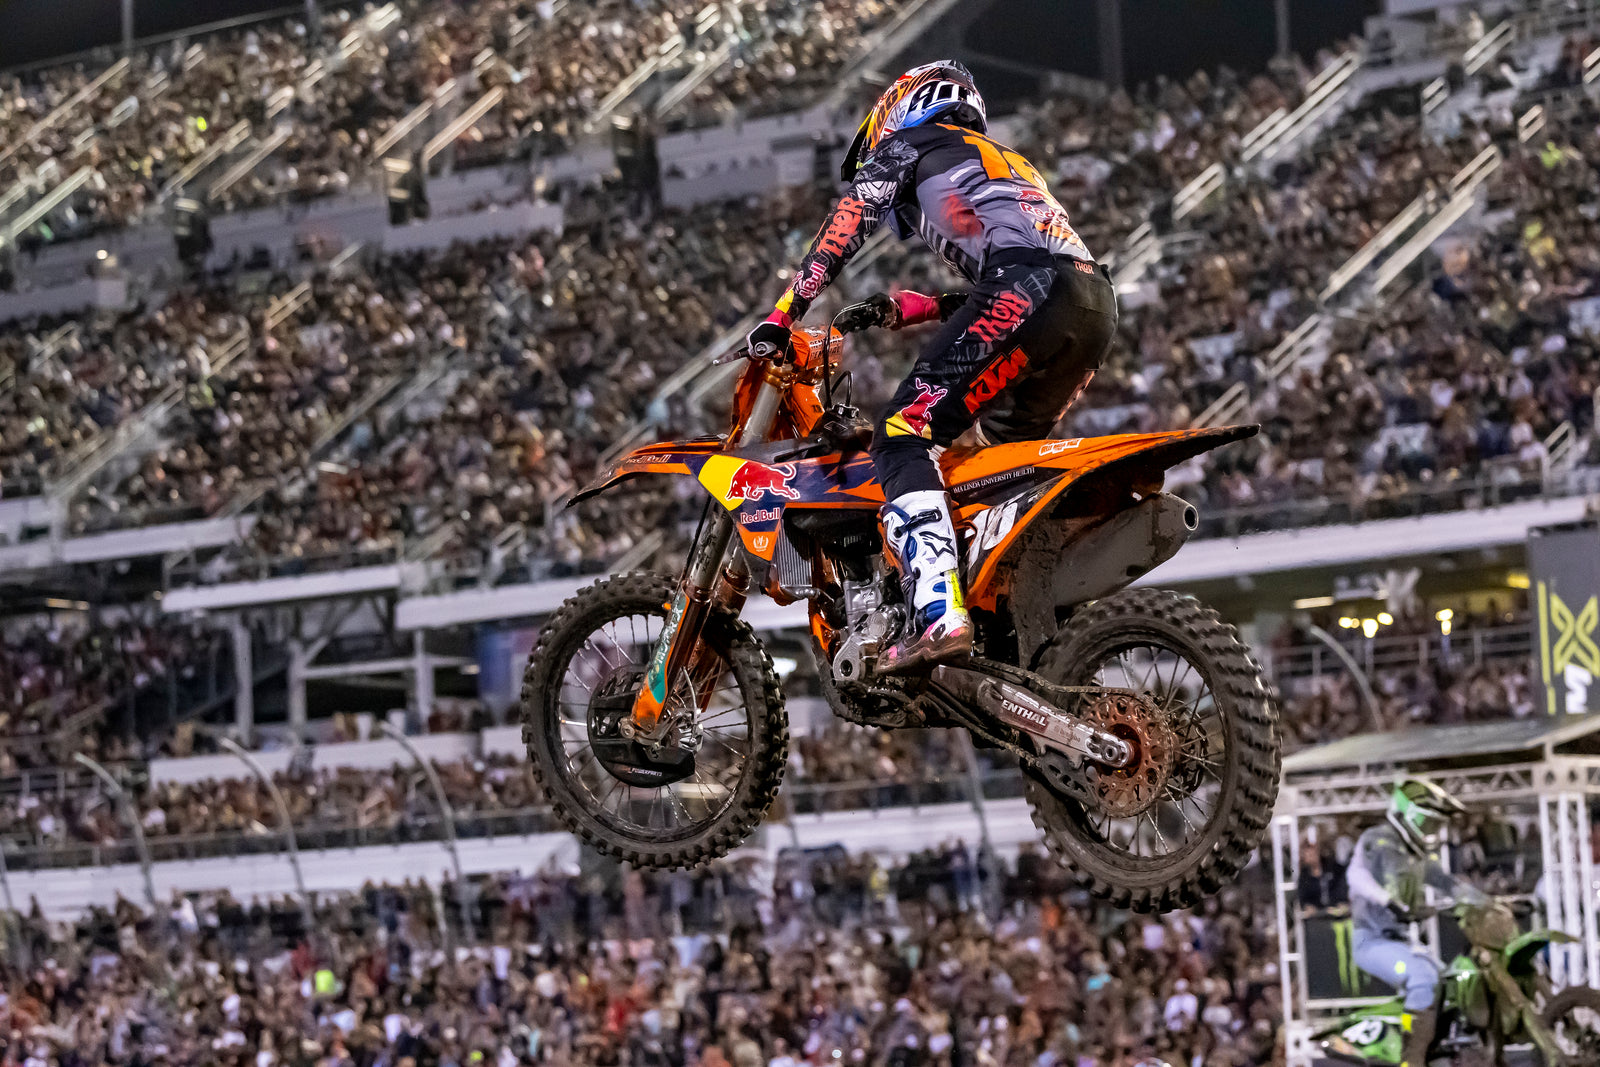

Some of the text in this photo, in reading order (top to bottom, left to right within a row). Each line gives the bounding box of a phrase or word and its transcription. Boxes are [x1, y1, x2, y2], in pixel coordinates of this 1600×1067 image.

[815, 195, 866, 258] THOR
[1073, 260, 1095, 275] THOR
[967, 289, 1032, 342] THOR
[963, 345, 1030, 415] KTM
[980, 474, 1014, 489] UNIVERSITY
[740, 507, 780, 524] Red Bull
